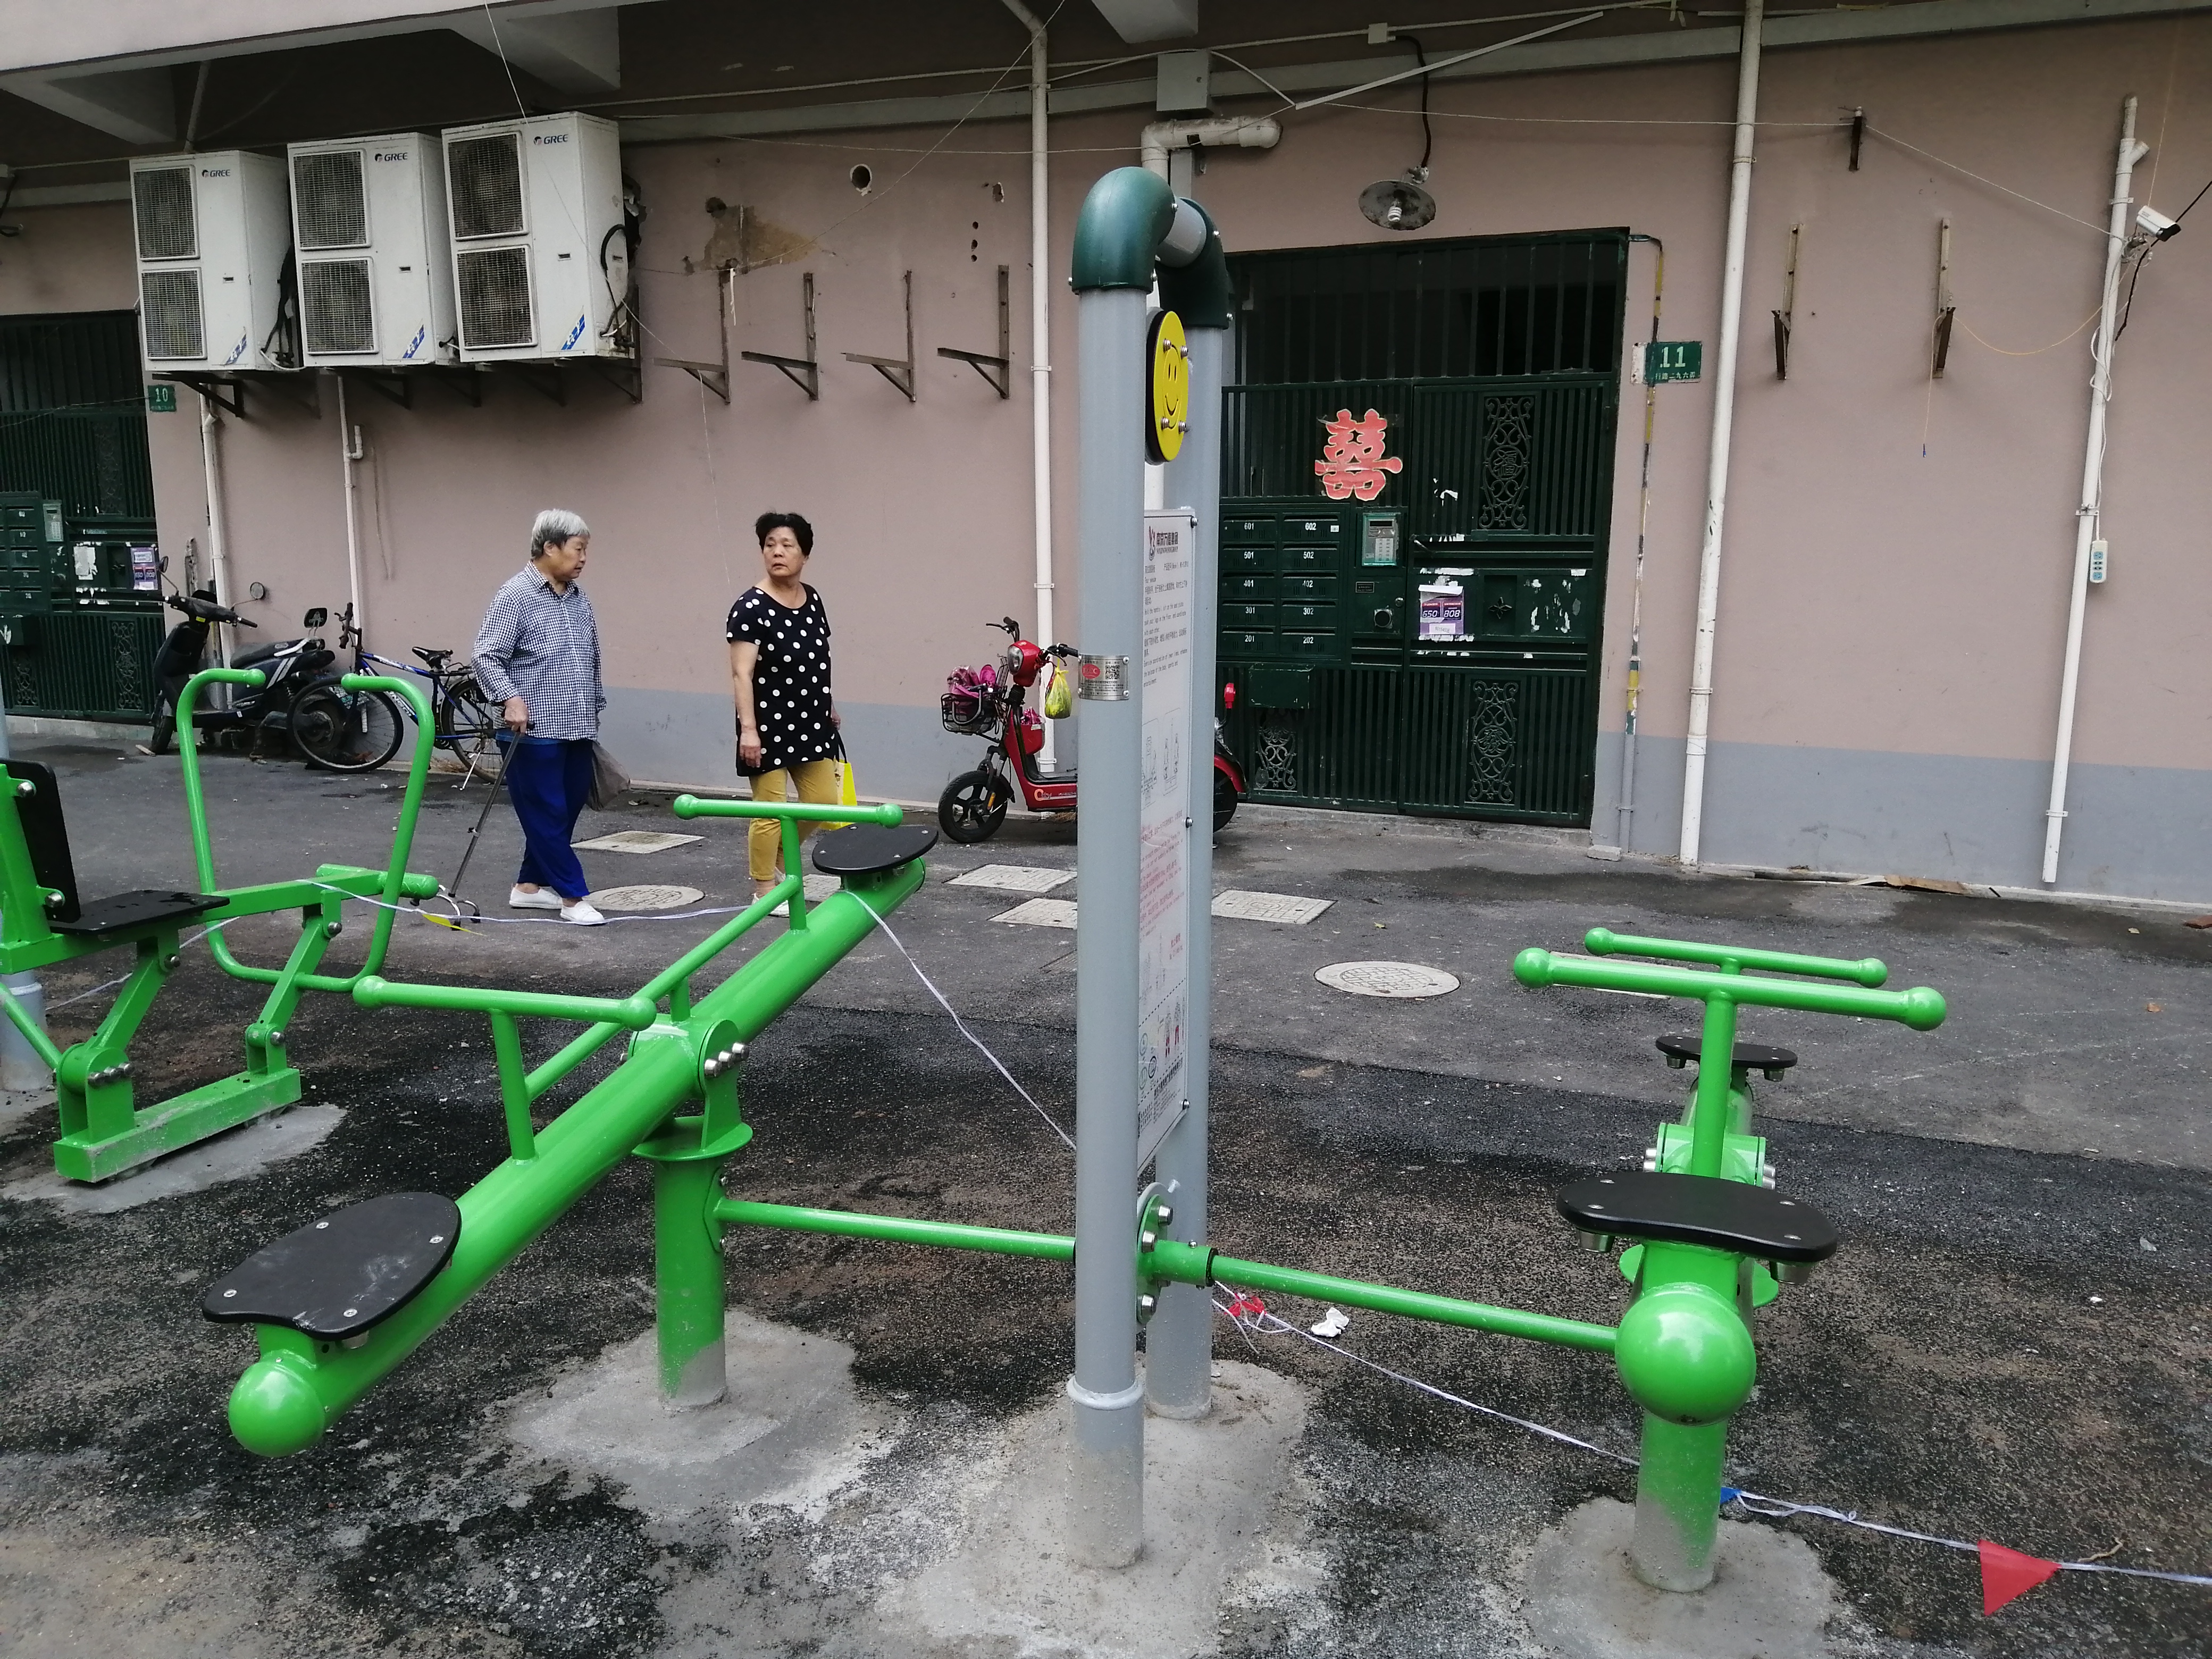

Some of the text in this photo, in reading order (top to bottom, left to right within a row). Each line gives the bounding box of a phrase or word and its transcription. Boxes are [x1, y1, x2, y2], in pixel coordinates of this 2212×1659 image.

[544, 134, 568, 144] GREE
[384, 152, 408, 161] GREE
[1660, 346, 1686, 368] 11
[1655, 371, 1695, 380] 行路二九六弄
[155, 388, 168, 402] 10
[1305, 522, 1317, 531] 602
[1244, 551, 1254, 559] 501
[1303, 551, 1314, 559] 502
